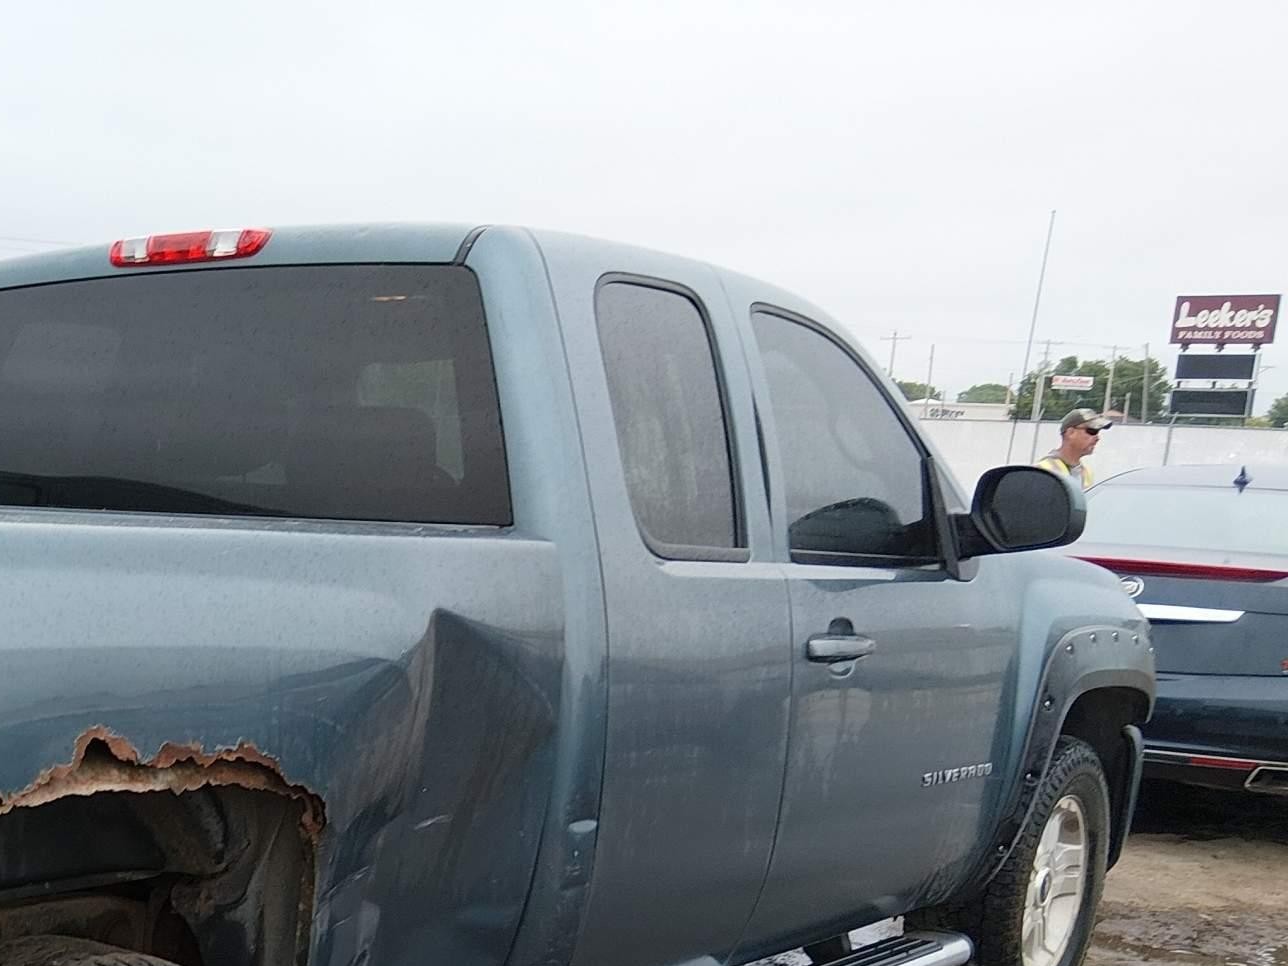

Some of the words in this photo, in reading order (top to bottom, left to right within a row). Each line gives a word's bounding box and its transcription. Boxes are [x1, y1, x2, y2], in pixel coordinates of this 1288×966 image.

[1175, 301, 1274, 328] Leeker's
[1176, 330, 1224, 340] FAMILY
[1222, 330, 1265, 340] FOODS
[922, 762, 993, 787] SILVERADO
